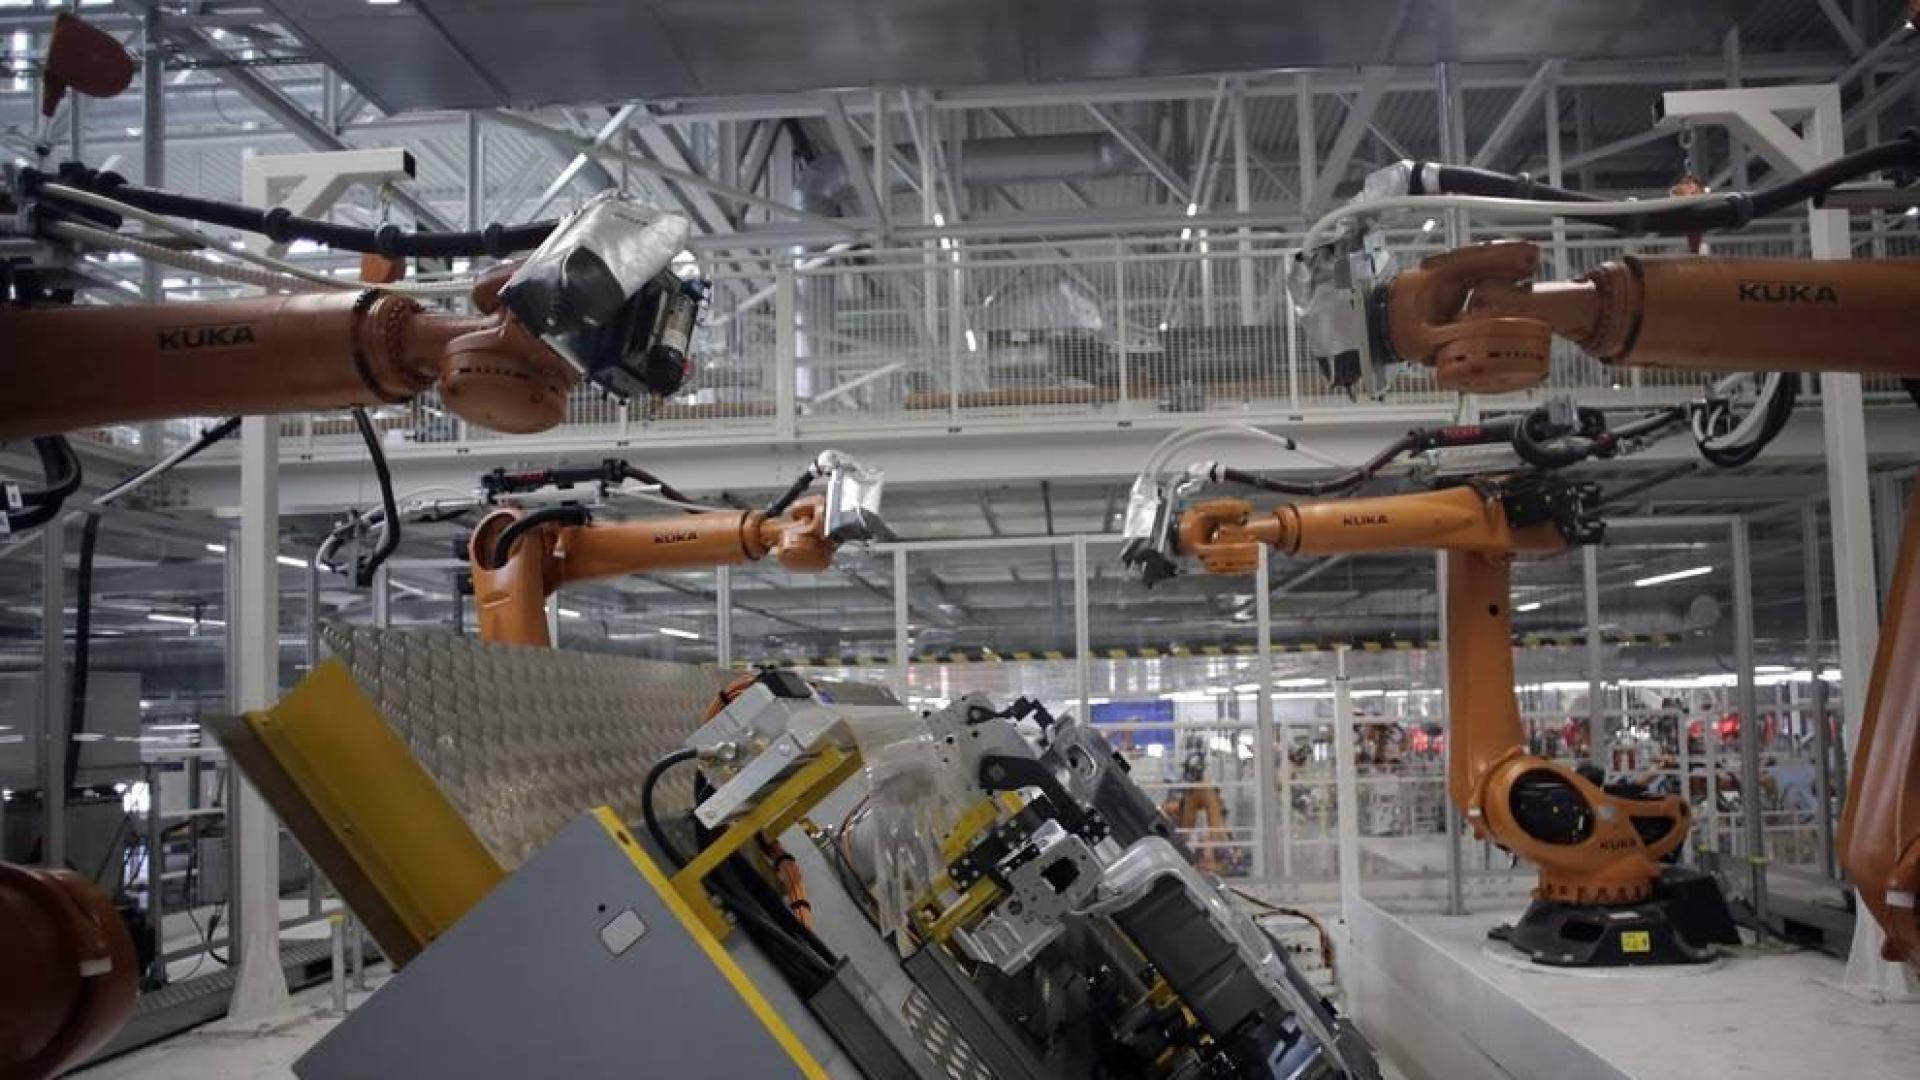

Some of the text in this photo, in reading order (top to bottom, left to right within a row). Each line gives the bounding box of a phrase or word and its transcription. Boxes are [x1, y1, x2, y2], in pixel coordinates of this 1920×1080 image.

[1738, 283, 1838, 303] KUKA
[158, 326, 257, 350] KUKA
[1343, 514, 1388, 526] KUKA
[654, 532, 698, 544] KUKA
[1599, 839, 1637, 850] KUKA
